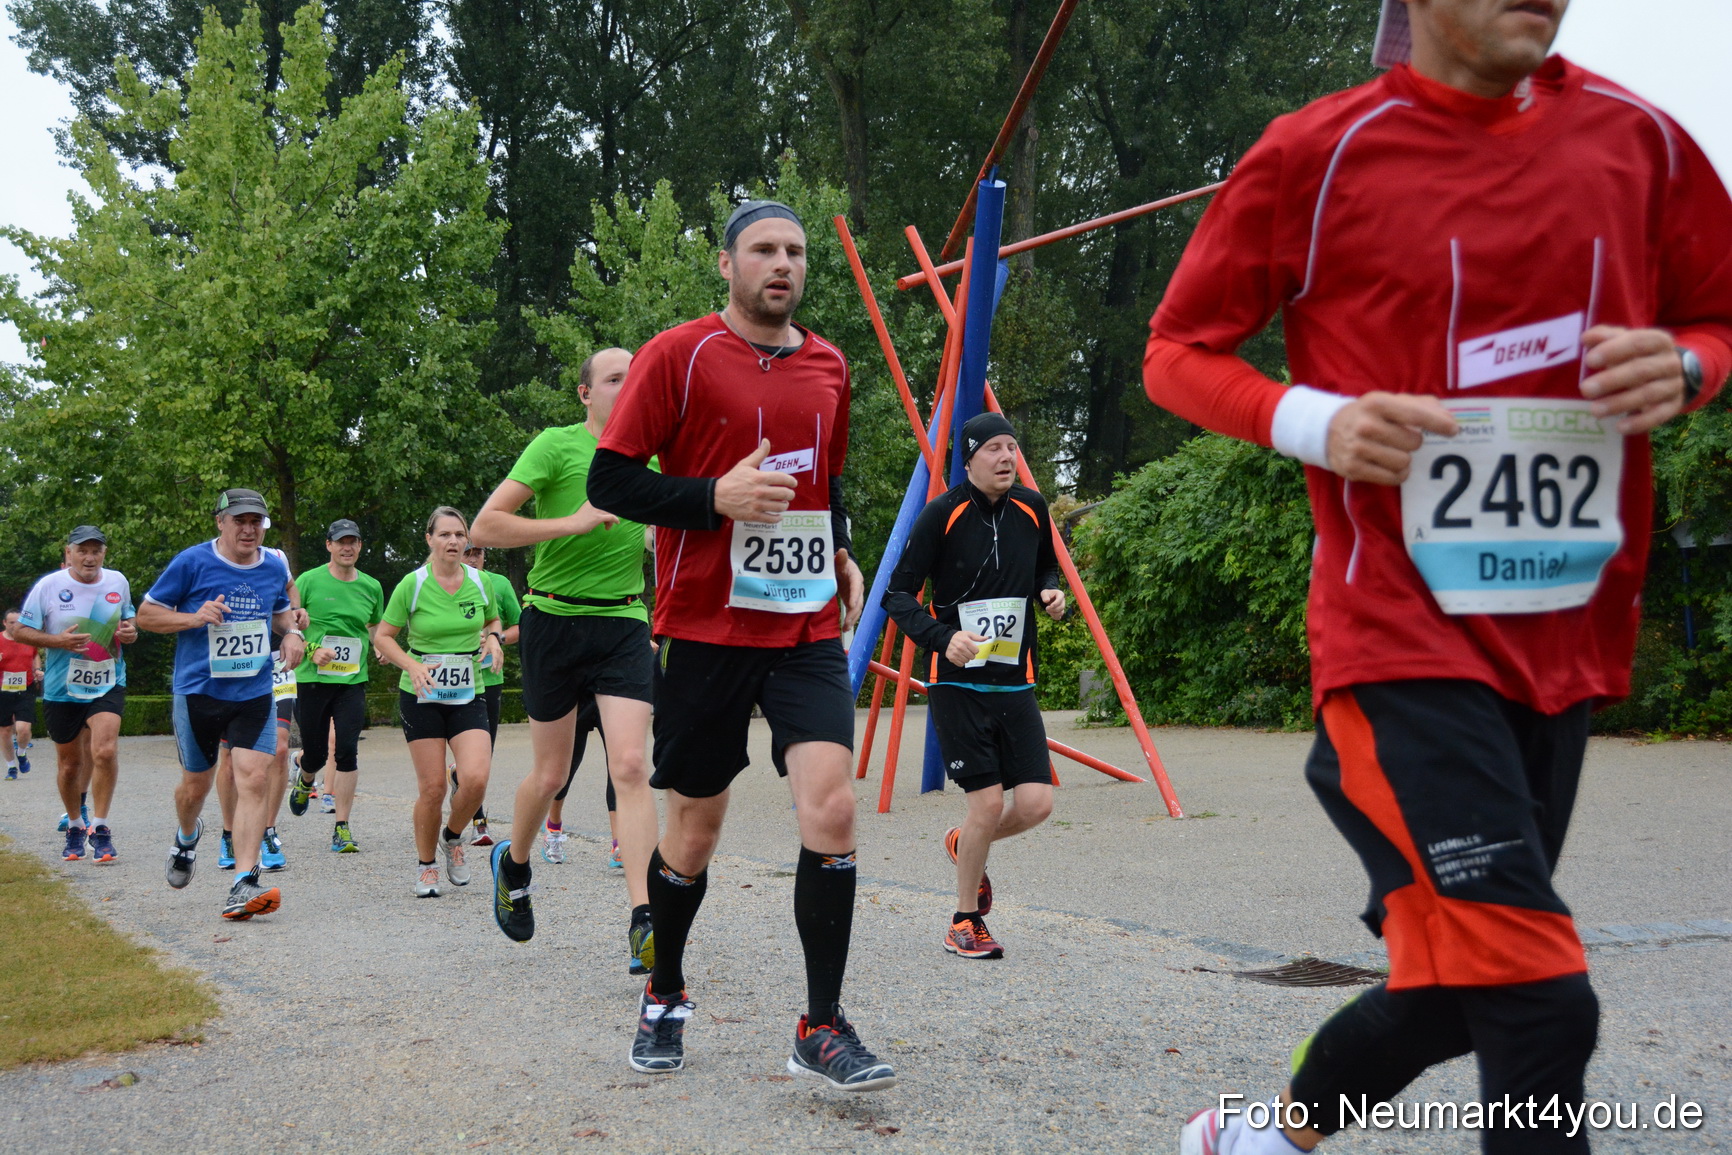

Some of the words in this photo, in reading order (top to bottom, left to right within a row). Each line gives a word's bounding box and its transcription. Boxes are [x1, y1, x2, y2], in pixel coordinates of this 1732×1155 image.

[1494, 335, 1549, 365] DEHN
[1507, 407, 1604, 435] BOCK
[774, 457, 800, 471] DEHN
[1430, 453, 1601, 529] 2462
[743, 521, 778, 530] NeuerMarkt
[782, 514, 826, 528] BOCK
[743, 535, 826, 575] 2538
[1479, 551, 1568, 581] Daniel
[763, 584, 807, 602] Jürgen
[977, 614, 1017, 639] 262
[215, 633, 264, 657] 2257
[231, 660, 253, 670] Josef
[331, 663, 347, 671] Peter
[8, 676, 23, 685] 129
[72, 669, 111, 686] 2651
[437, 691, 457, 699] Heike
